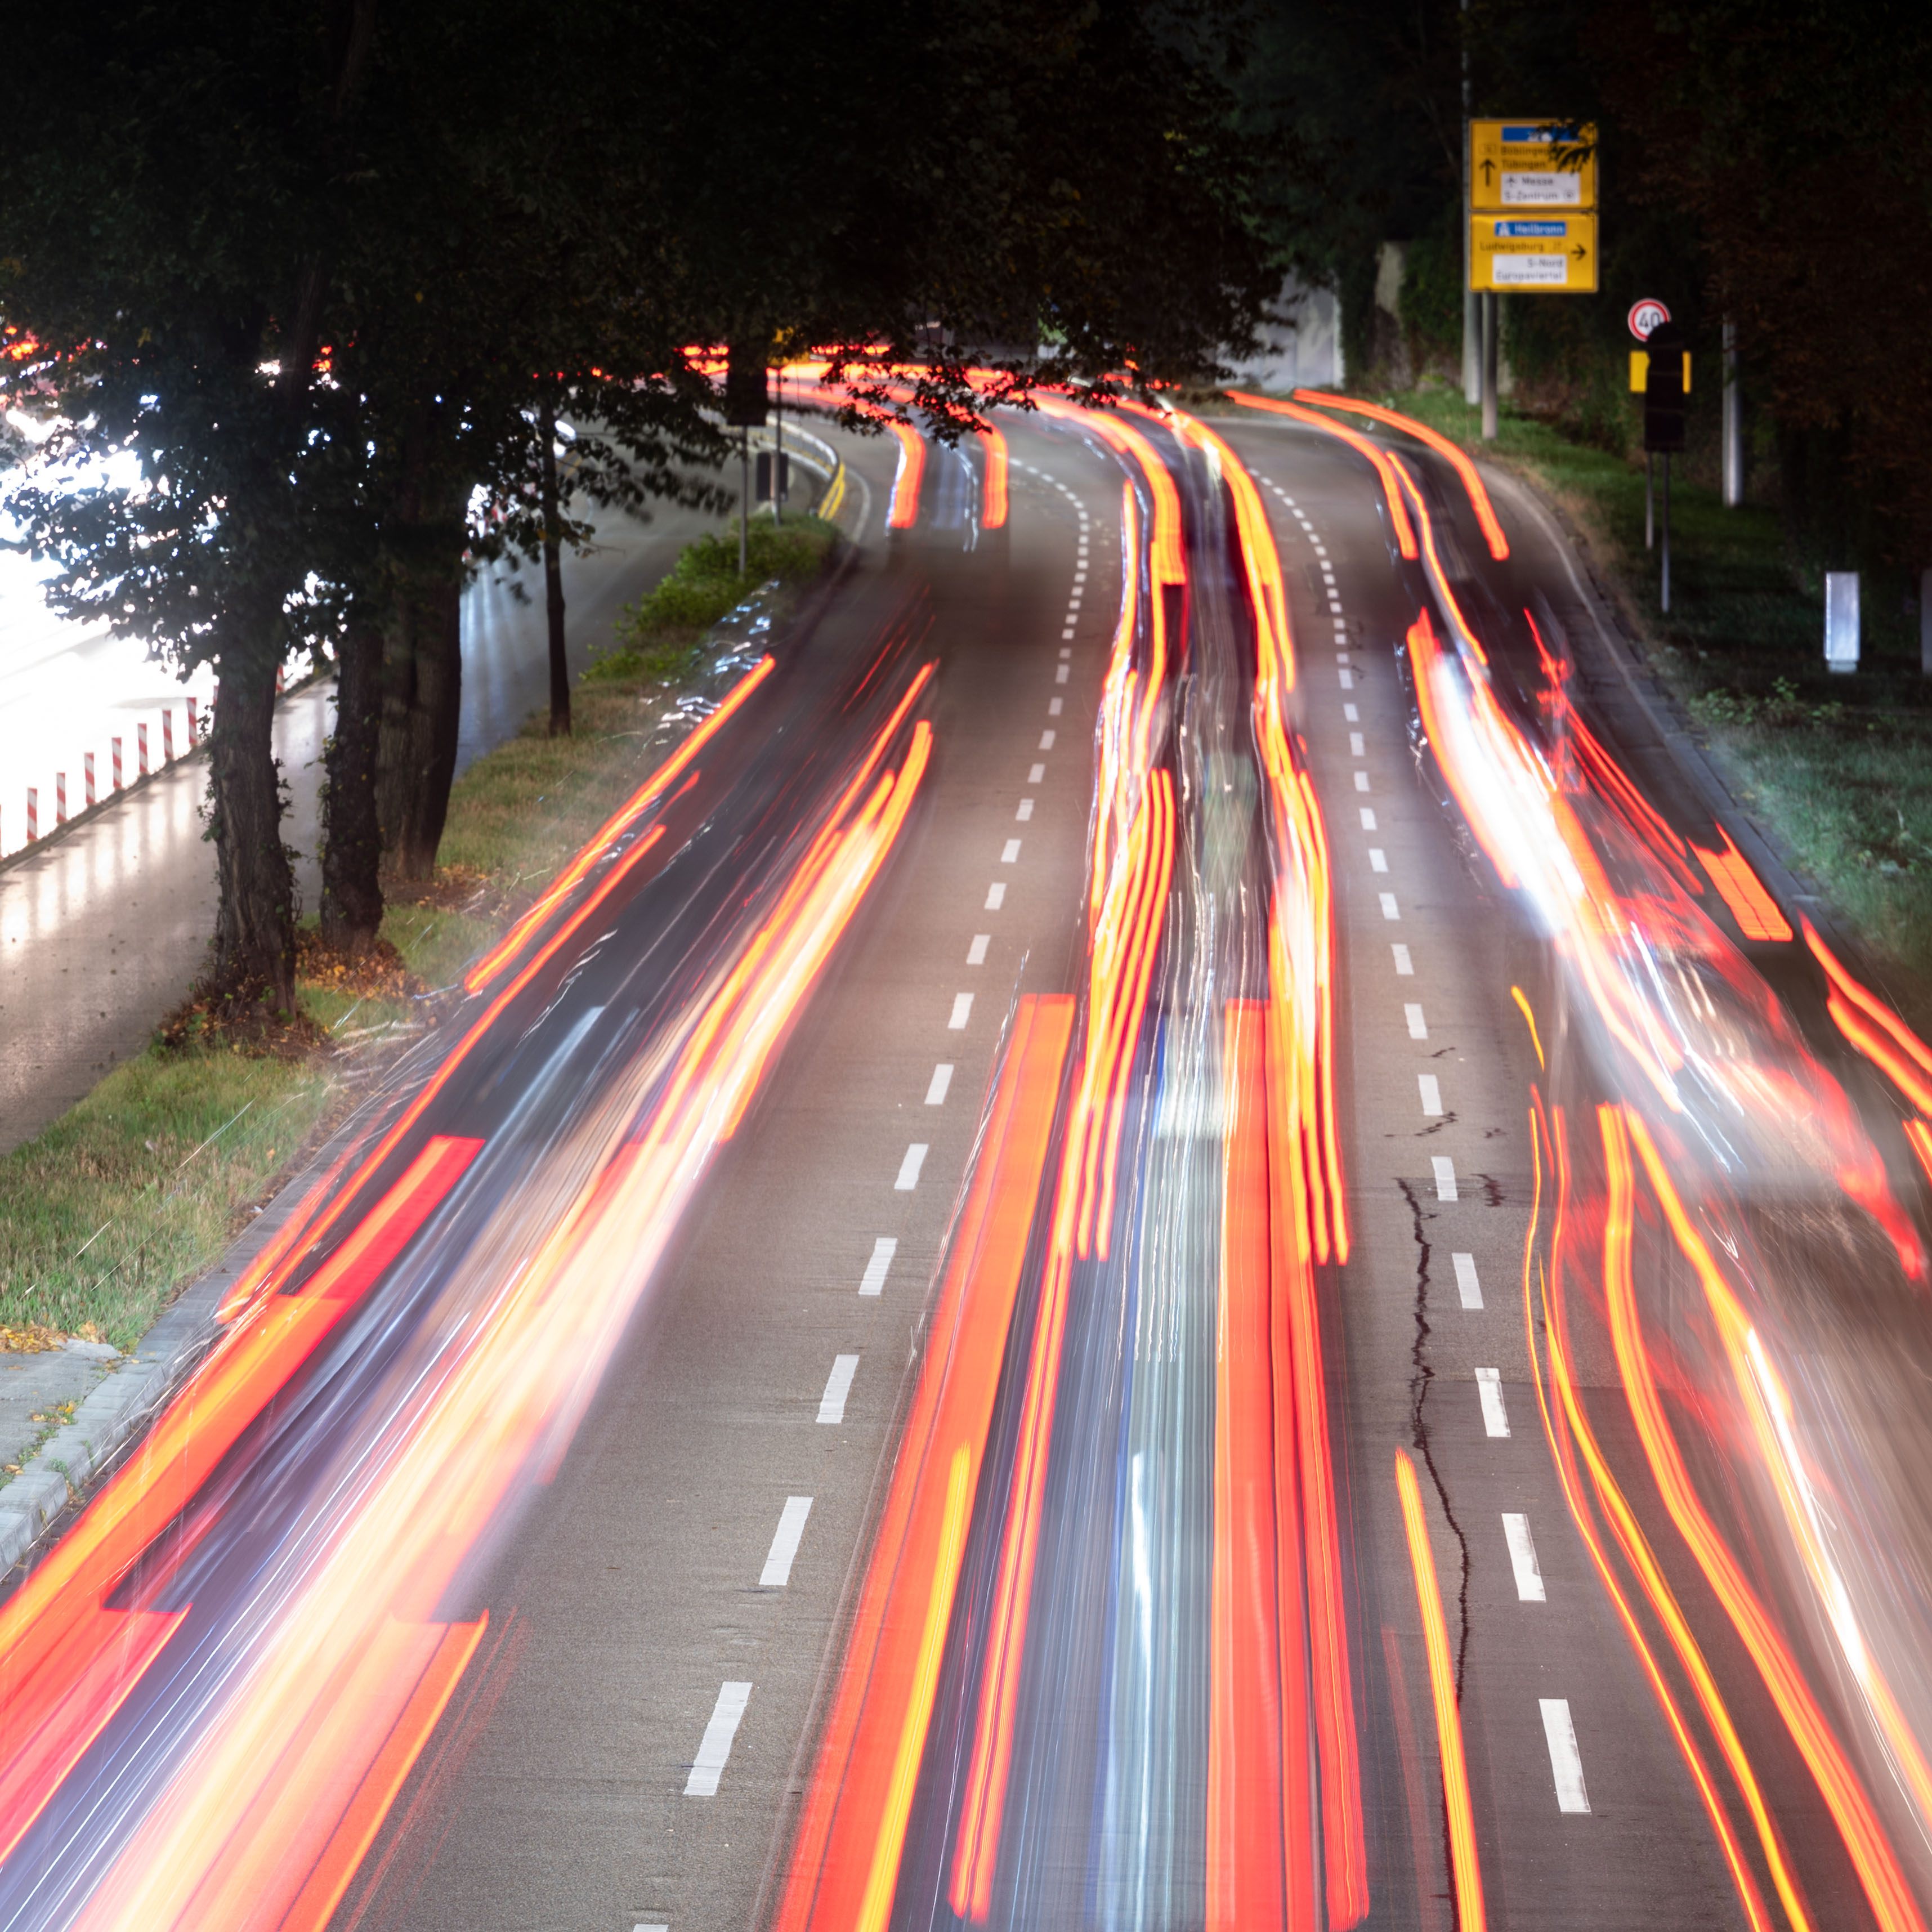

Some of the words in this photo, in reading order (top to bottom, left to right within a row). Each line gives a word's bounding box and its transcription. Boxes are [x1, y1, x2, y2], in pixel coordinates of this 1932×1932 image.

[1522, 176, 1554, 186] Messe
[1515, 223, 1563, 235] Heilbronn
[1479, 241, 1544, 253] Ludwigsburg
[1527, 257, 1563, 268] S-Nord
[1639, 311, 1661, 328] 40
